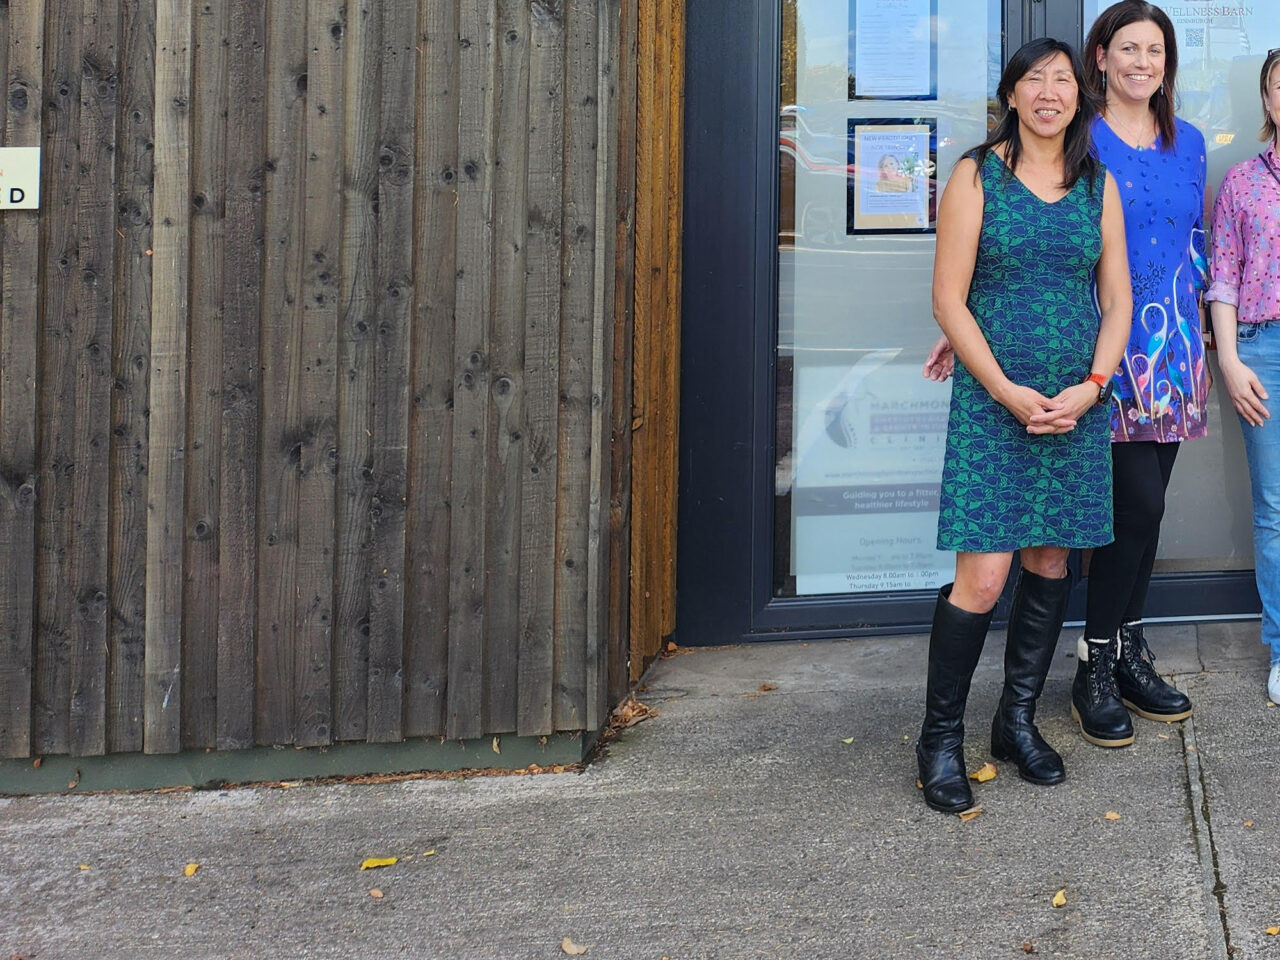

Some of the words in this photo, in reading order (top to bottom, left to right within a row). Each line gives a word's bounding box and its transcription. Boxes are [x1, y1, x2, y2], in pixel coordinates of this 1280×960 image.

[1222, 6, 1254, 17] BARN
[869, 399, 950, 410] MARCHMON
[879, 491, 895, 500] you
[897, 489, 906, 497] to
[895, 498, 929, 509] lifestyle
[846, 571, 882, 581] Wednesday
[849, 581, 878, 590] Thursday
